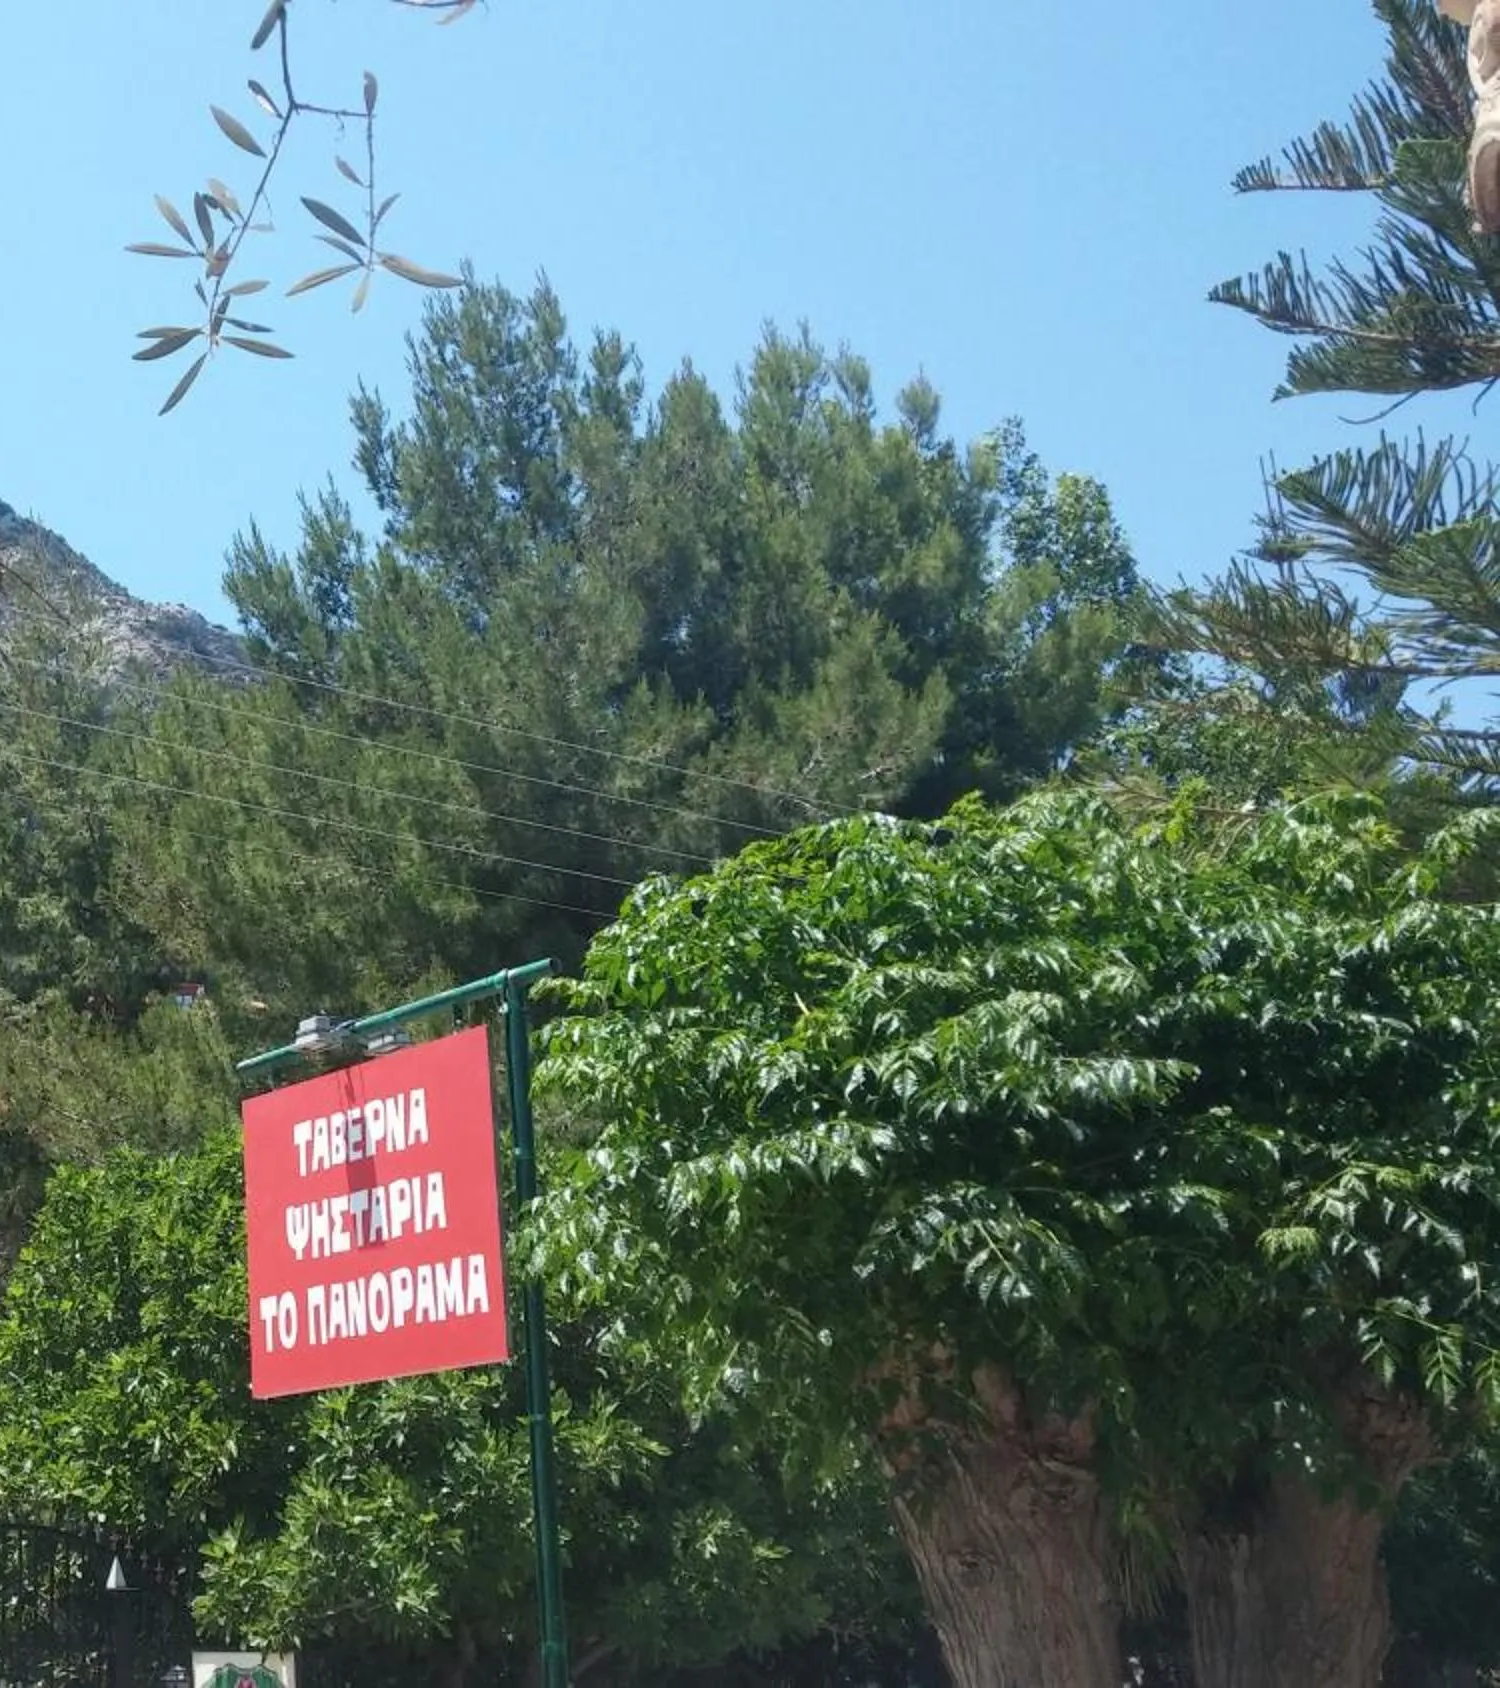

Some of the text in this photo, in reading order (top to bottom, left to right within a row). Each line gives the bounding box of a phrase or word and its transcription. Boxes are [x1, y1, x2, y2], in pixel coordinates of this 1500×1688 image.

[293, 1087, 429, 1177] ΤΑΒΕΡΝΑ
[285, 1171, 448, 1261] ΨΗΣΤΑΡΙΑ
[260, 1253, 490, 1353] ΤΟ ΠΑΝΟΡΑΜΑ
